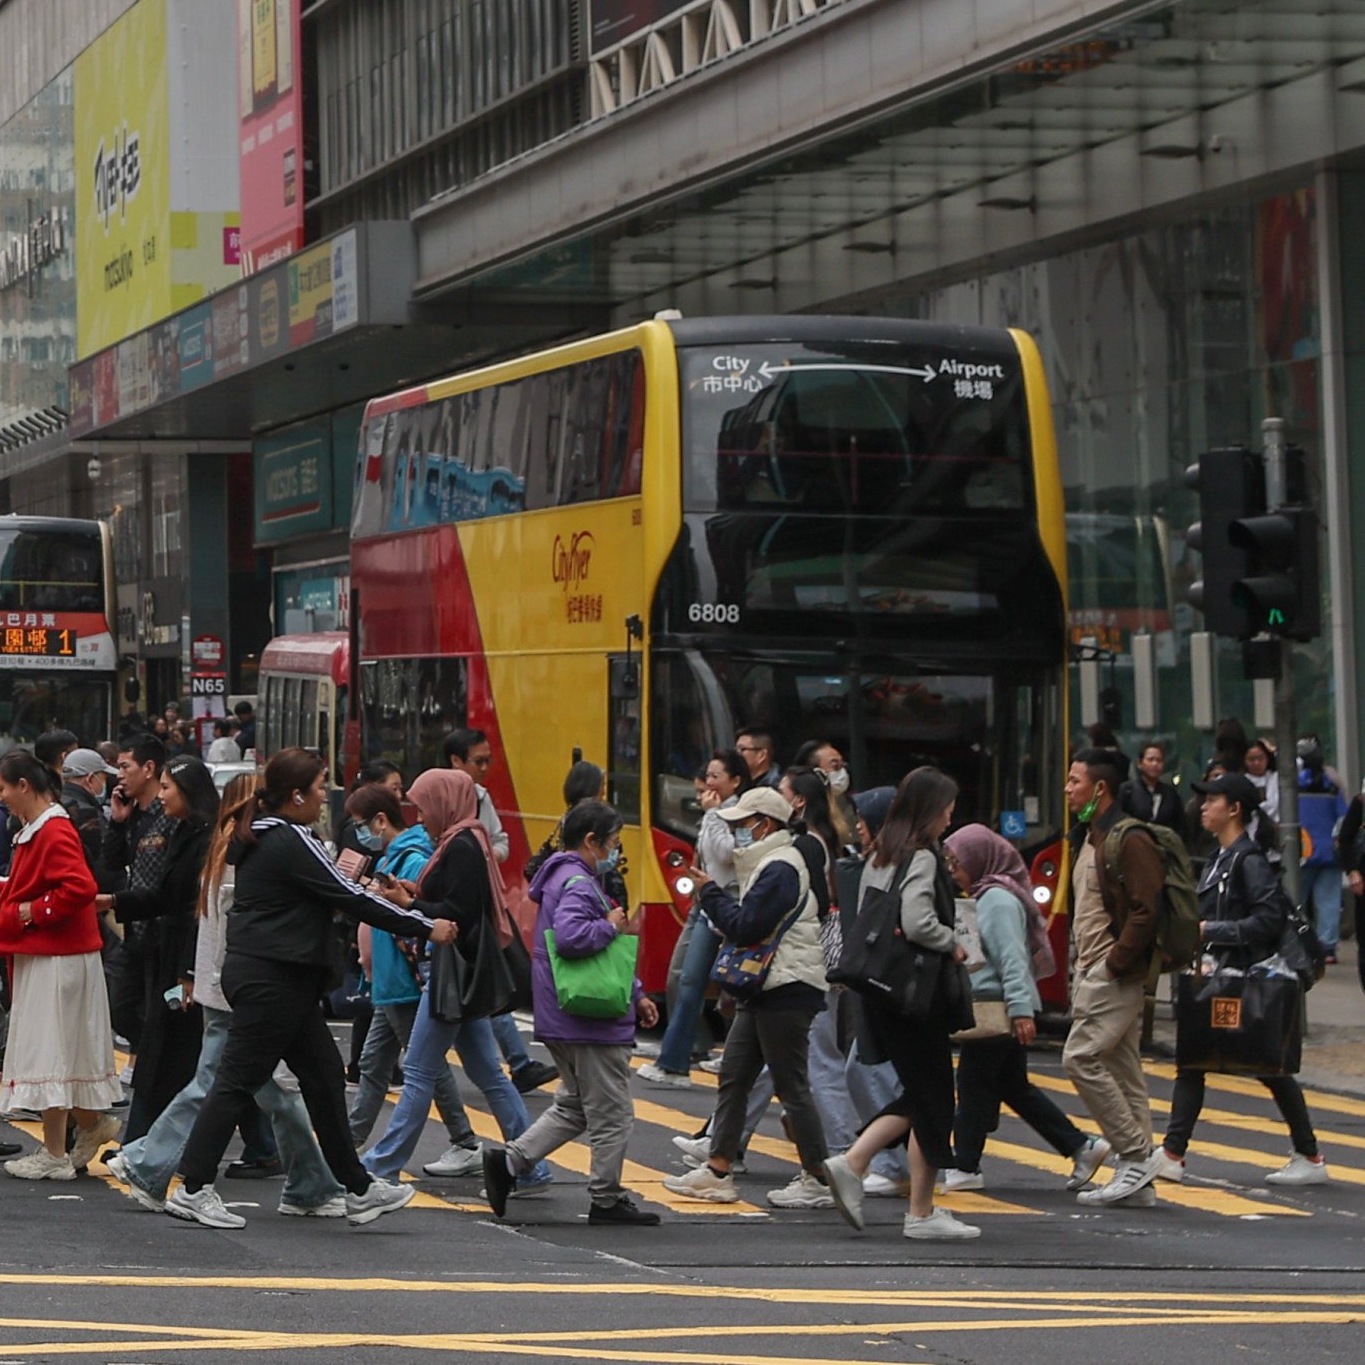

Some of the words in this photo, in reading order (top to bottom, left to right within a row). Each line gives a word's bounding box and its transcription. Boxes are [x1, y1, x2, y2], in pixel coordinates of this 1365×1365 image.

[712, 355, 750, 374] City
[938, 358, 1004, 380] Airport
[702, 375, 763, 394] 市中心
[954, 379, 994, 400] 機場
[688, 603, 741, 624] 6808
[58, 632, 73, 655] 1
